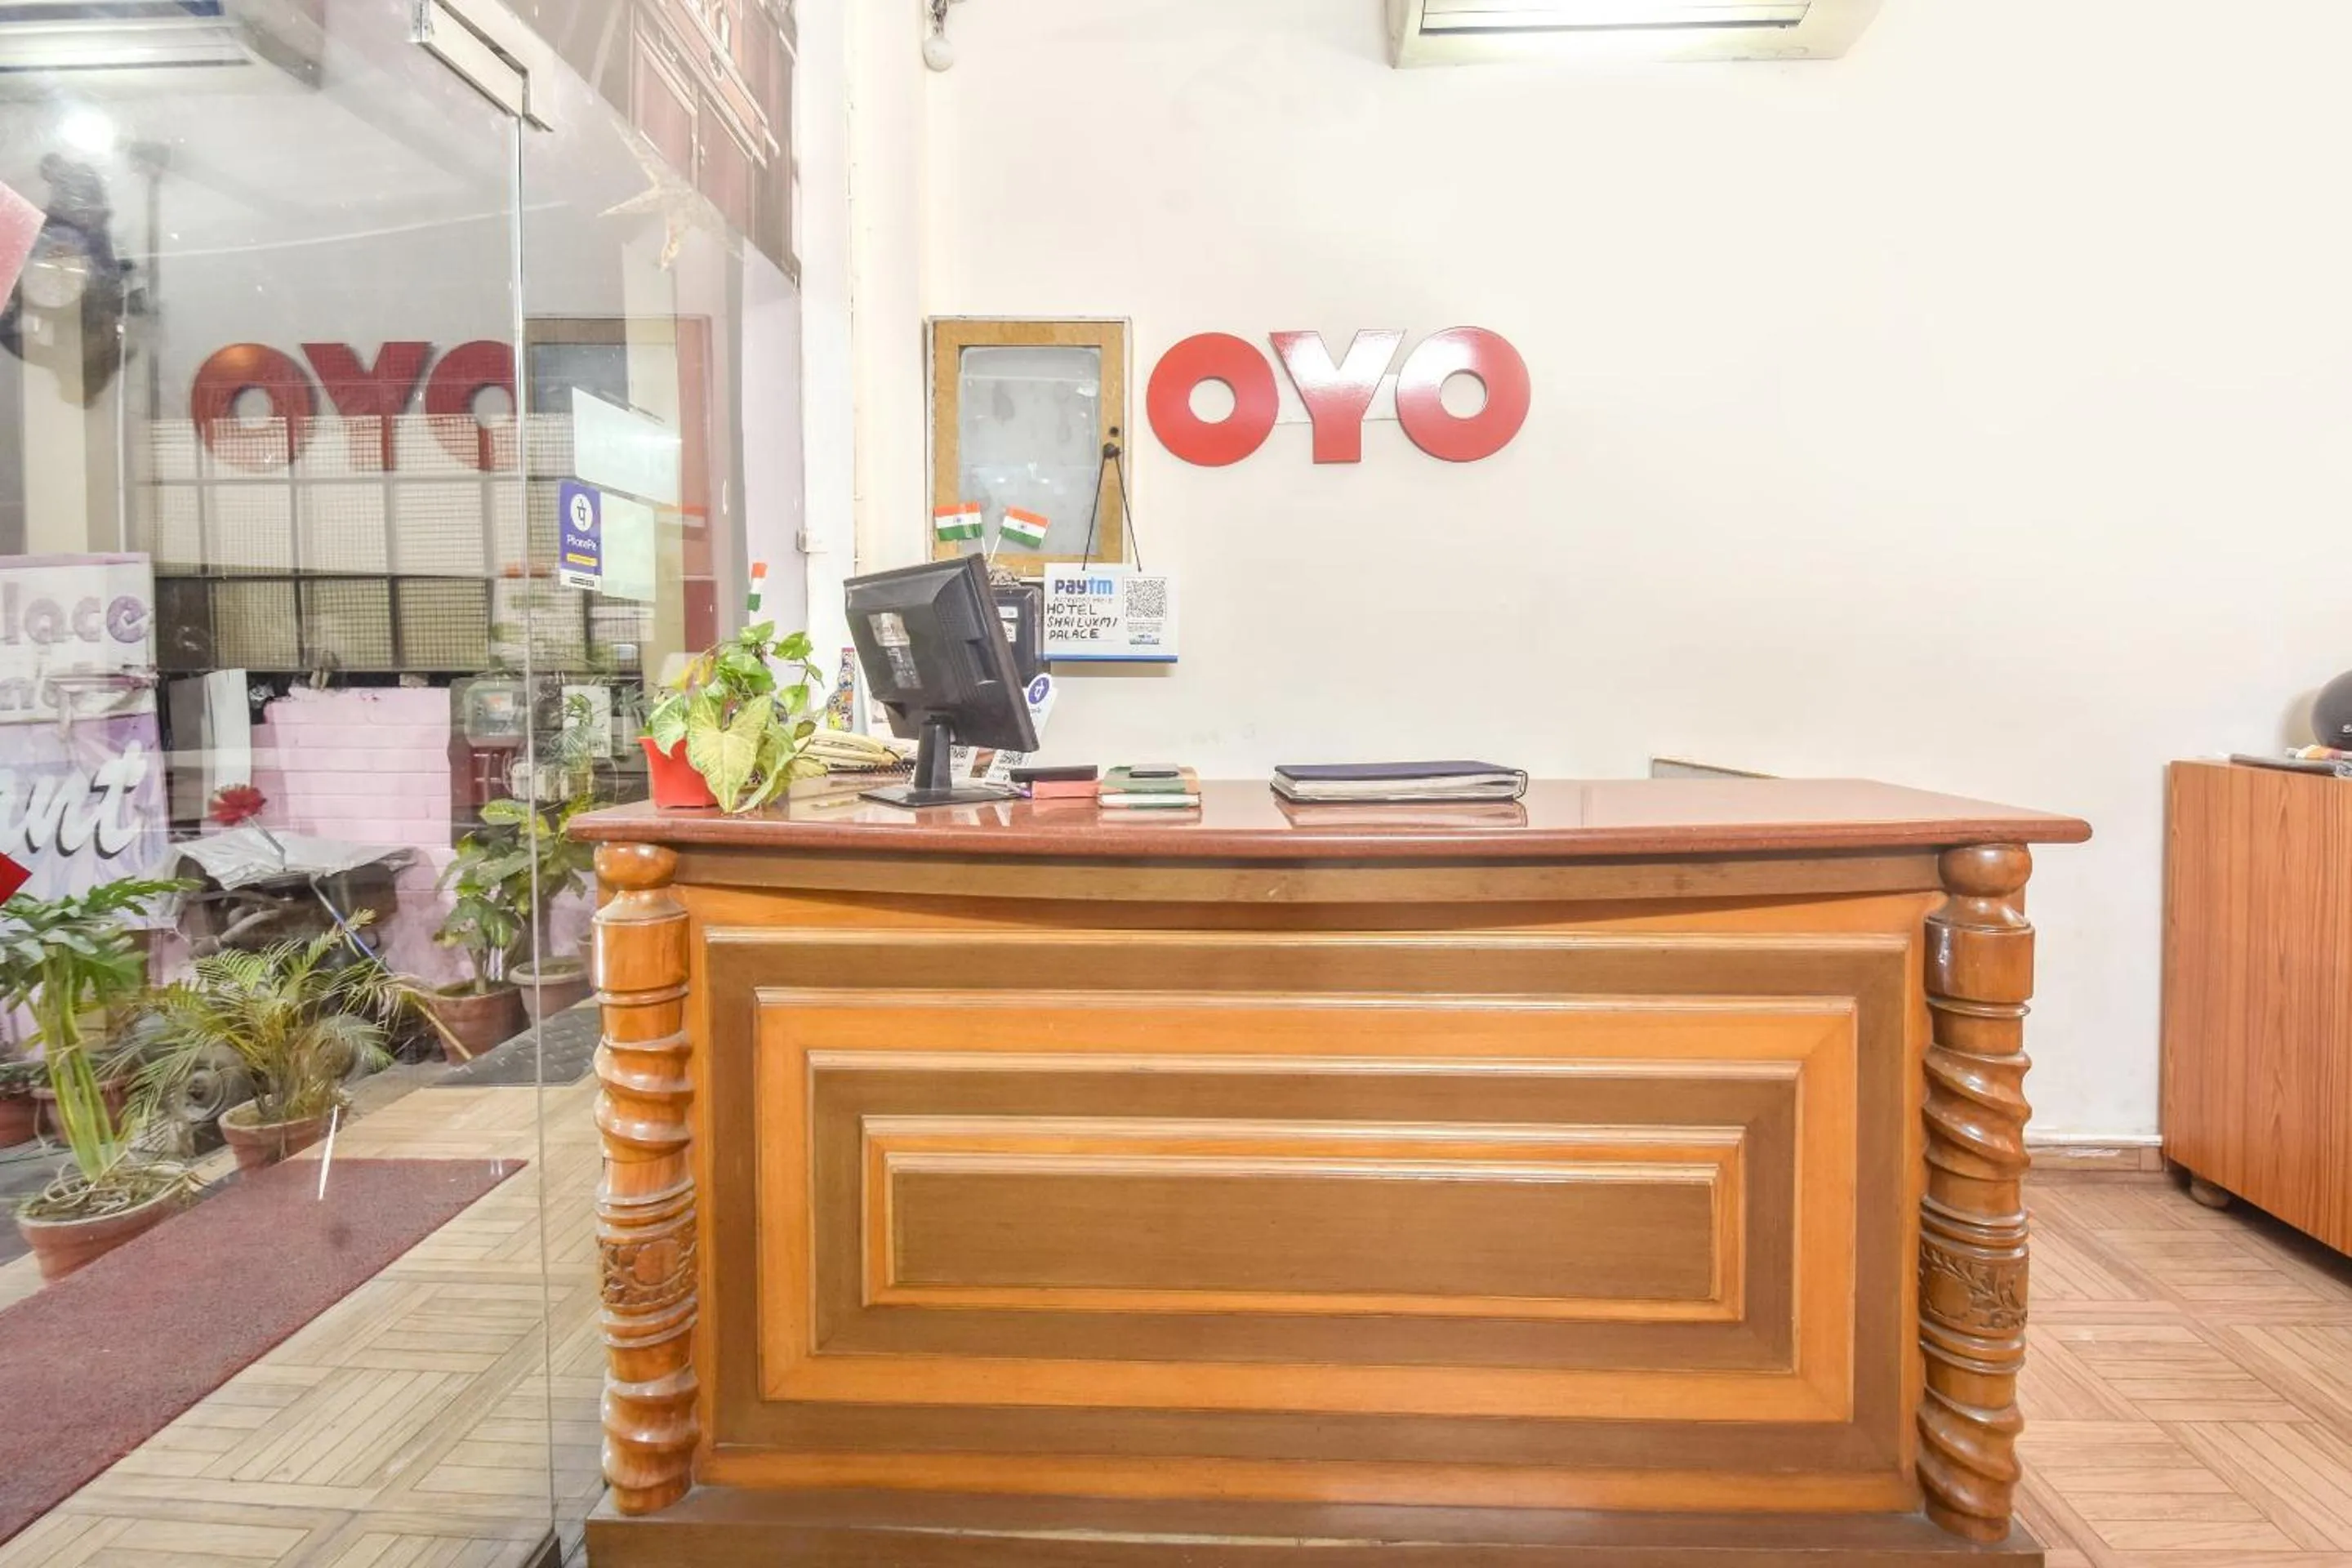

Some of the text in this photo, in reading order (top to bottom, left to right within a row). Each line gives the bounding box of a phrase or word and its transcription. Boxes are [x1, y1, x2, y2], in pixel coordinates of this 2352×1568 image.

[1146, 326, 1531, 466] OYO
[1046, 603, 1098, 615] HOTEL
[1048, 627, 1100, 640] PALACE
